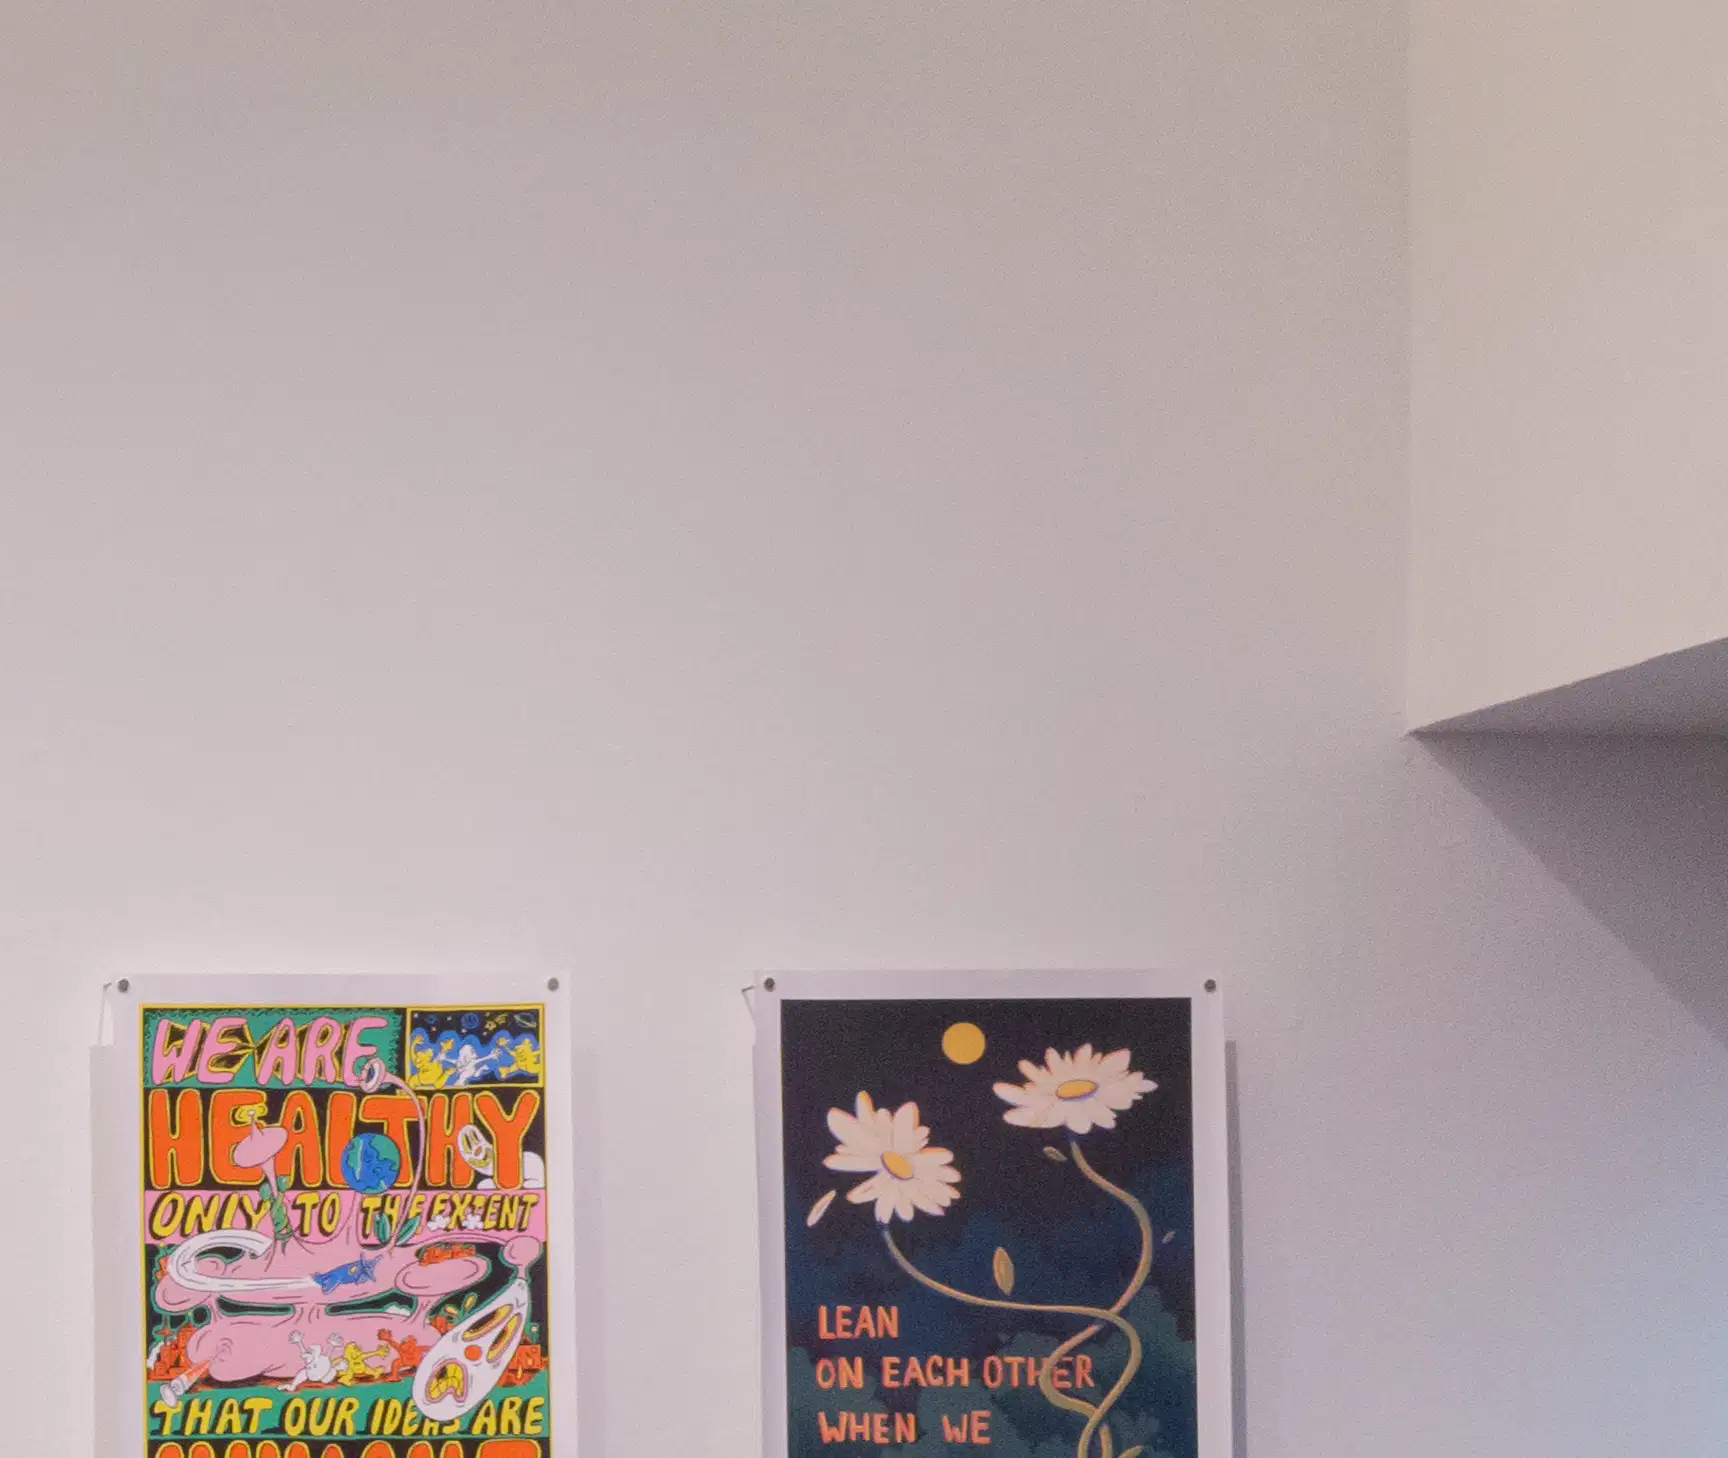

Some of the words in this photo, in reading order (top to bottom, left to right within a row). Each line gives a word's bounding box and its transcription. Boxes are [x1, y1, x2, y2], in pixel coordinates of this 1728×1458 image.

[151, 1016, 248, 1086] WE
[256, 1016, 388, 1087] ARE
[148, 1088, 541, 1190] HEALTHY
[149, 1191, 271, 1240] ONLY
[292, 1191, 341, 1237] TO
[818, 1304, 899, 1340] LEAN
[815, 1356, 864, 1390] ON
[881, 1355, 969, 1389] EACH
[982, 1355, 1095, 1390] OTHER
[151, 1397, 273, 1436] THAT
[281, 1396, 359, 1436] OUR
[471, 1396, 545, 1437] ARE
[817, 1411, 918, 1445] WHEN
[941, 1410, 992, 1445] WE
